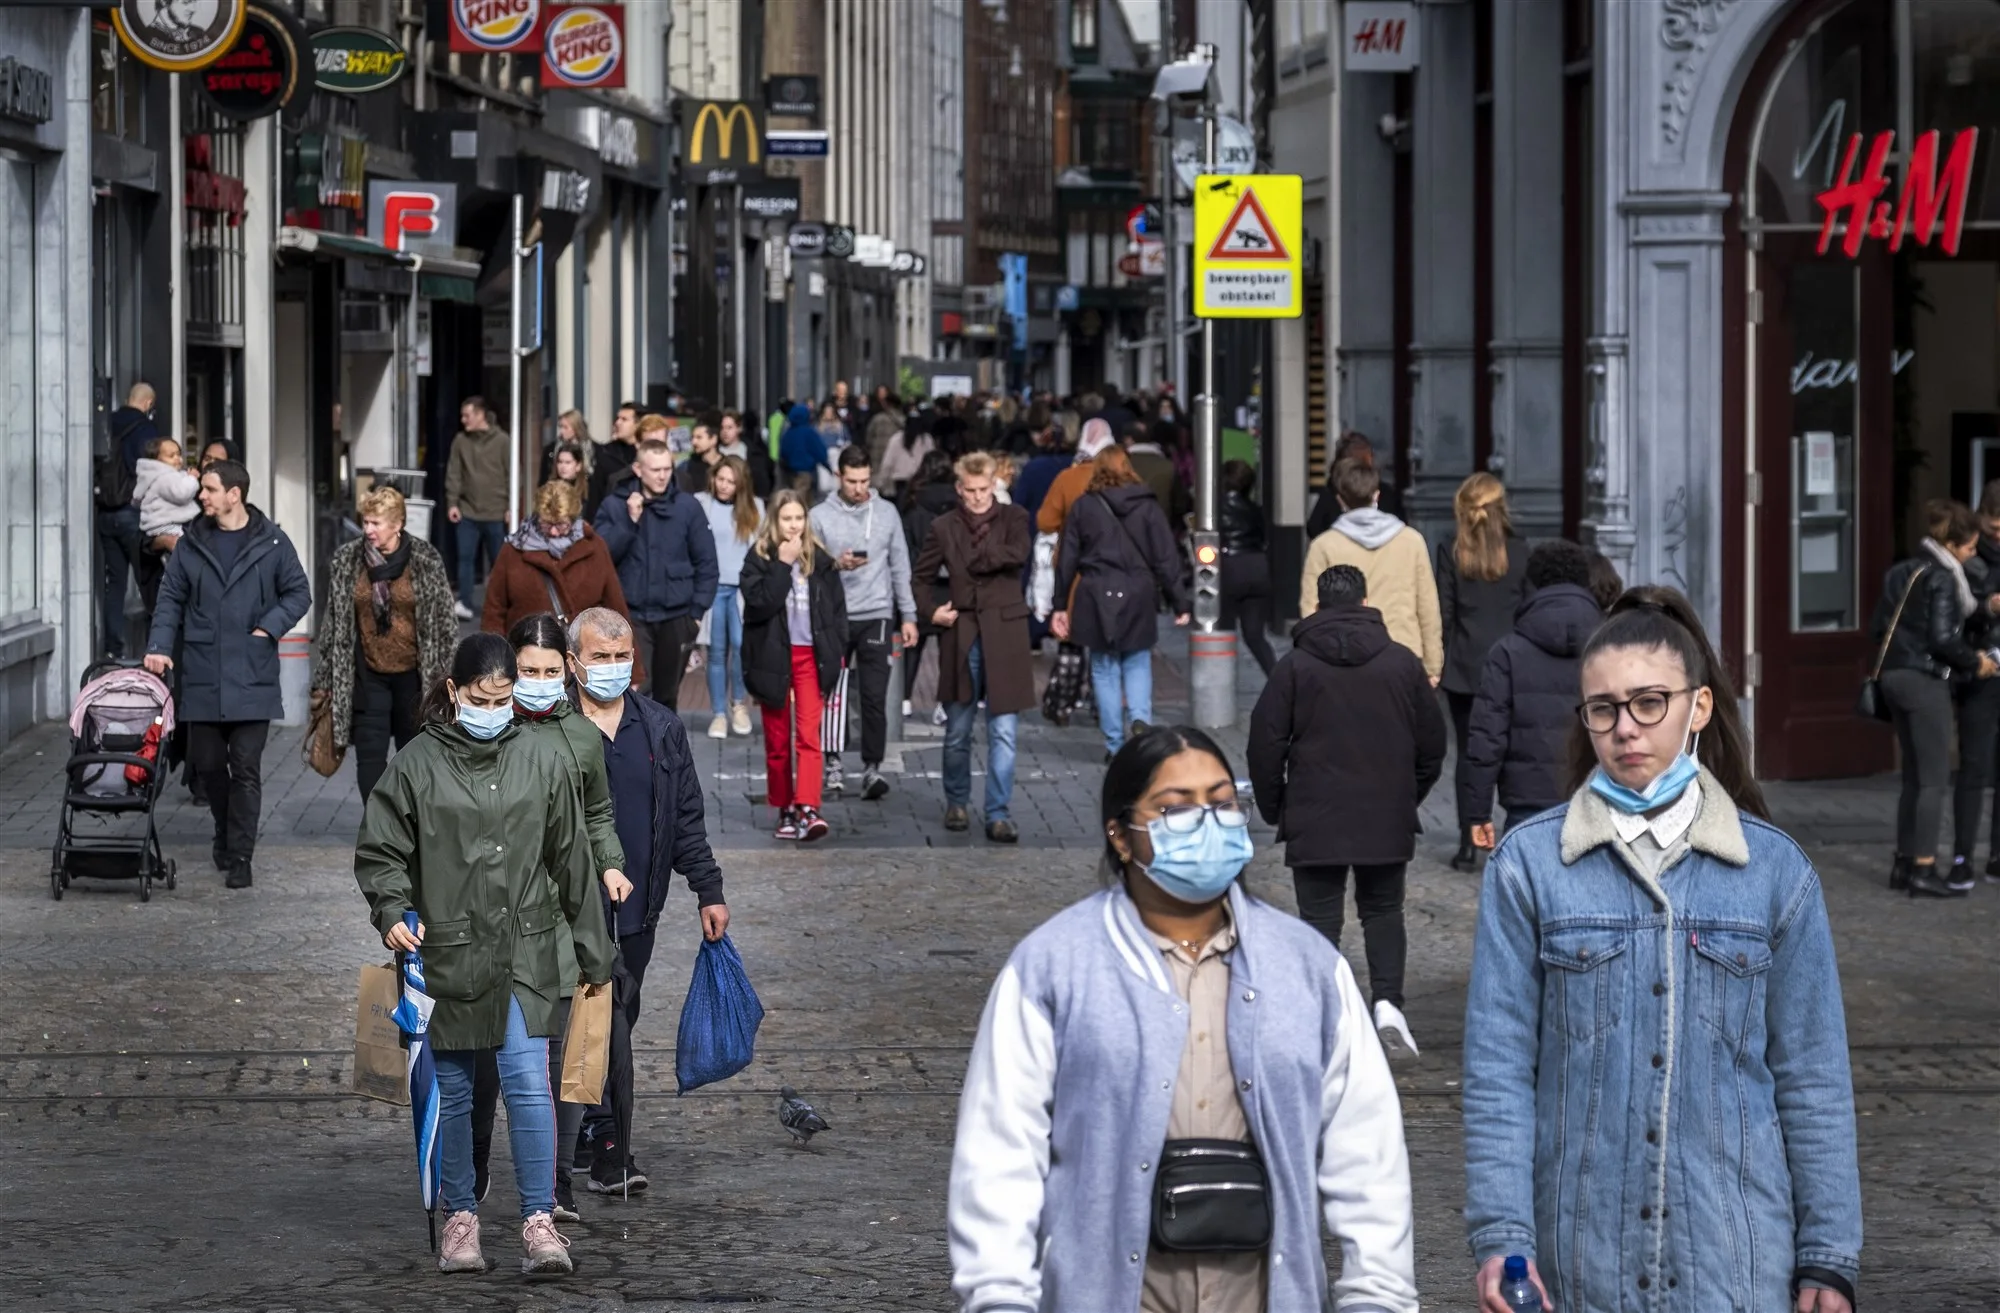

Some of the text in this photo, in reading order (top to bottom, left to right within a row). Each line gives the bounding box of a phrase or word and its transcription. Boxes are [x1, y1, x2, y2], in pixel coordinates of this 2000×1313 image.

[467, 0, 529, 32] KING
[149, 36, 180, 54] SINCE
[553, 20, 610, 49] BURGER
[313, 48, 405, 75] UBWAY
[557, 36, 613, 67] KING
[1816, 126, 1979, 258] H&M
[1209, 272, 1286, 287] beweegbaar
[1220, 290, 1276, 301] obstakel
